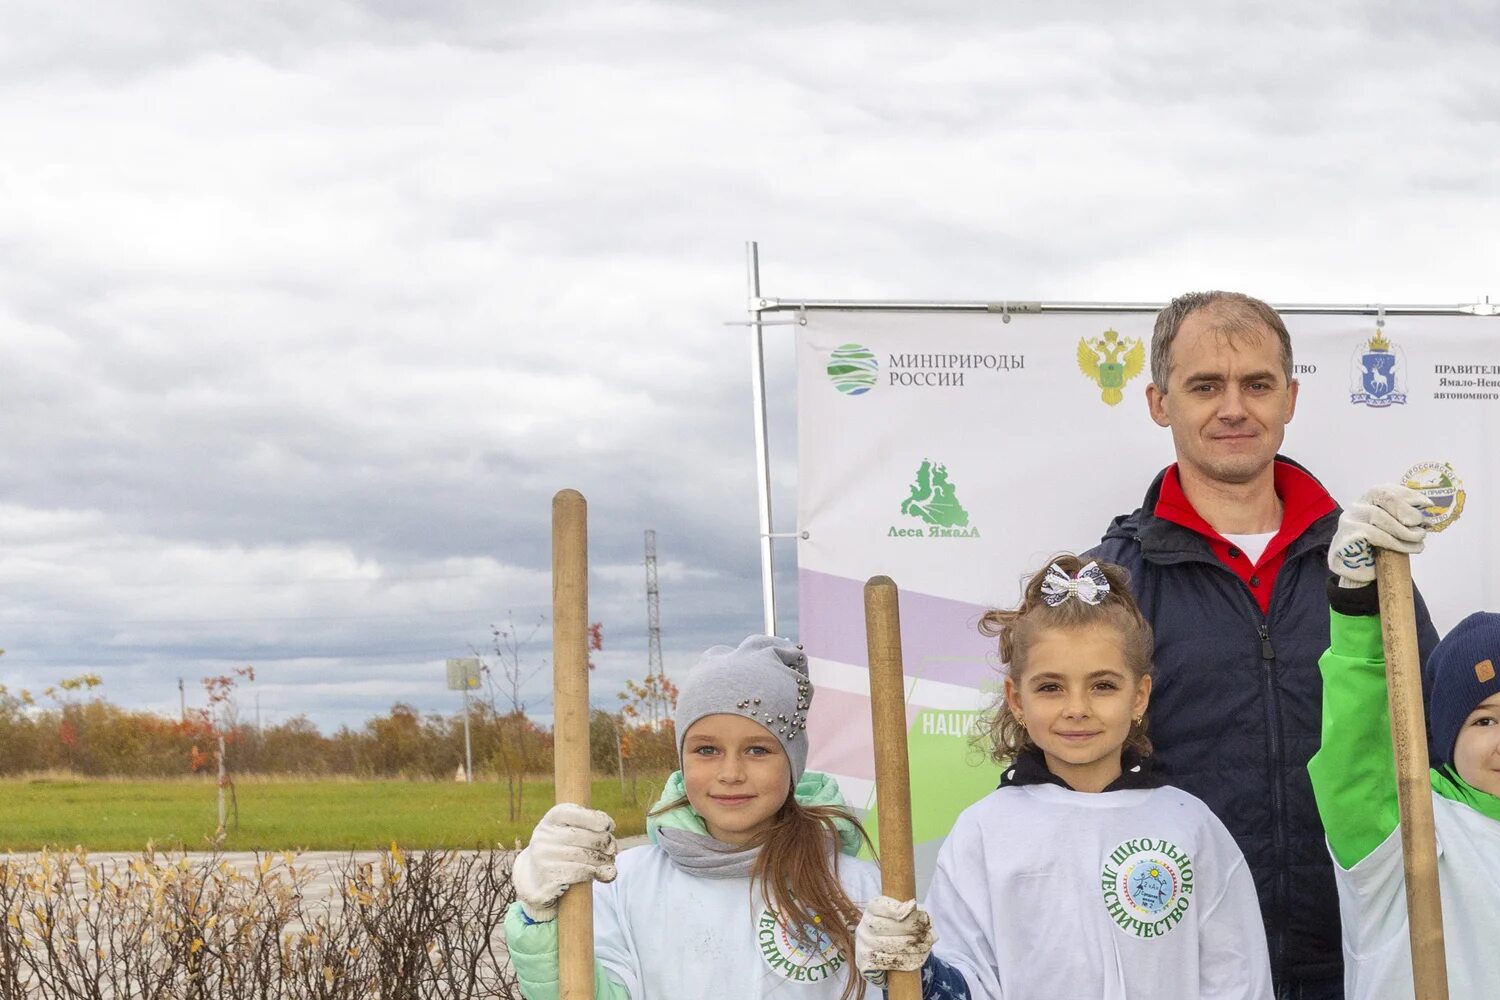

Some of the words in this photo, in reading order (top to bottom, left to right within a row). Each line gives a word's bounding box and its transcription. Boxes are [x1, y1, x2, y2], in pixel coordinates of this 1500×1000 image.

[889, 354, 1025, 371] МИНПРИРОДЫ
[889, 372, 965, 387] РОССИИ
[1433, 391, 1499, 401] автономного
[887, 526, 924, 537] Леса
[922, 712, 983, 738] НАЦИ
[1109, 838, 1194, 894] ШКОЛЬНОЕ
[1101, 864, 1190, 938] ЛЕСНИЧЕСТВО
